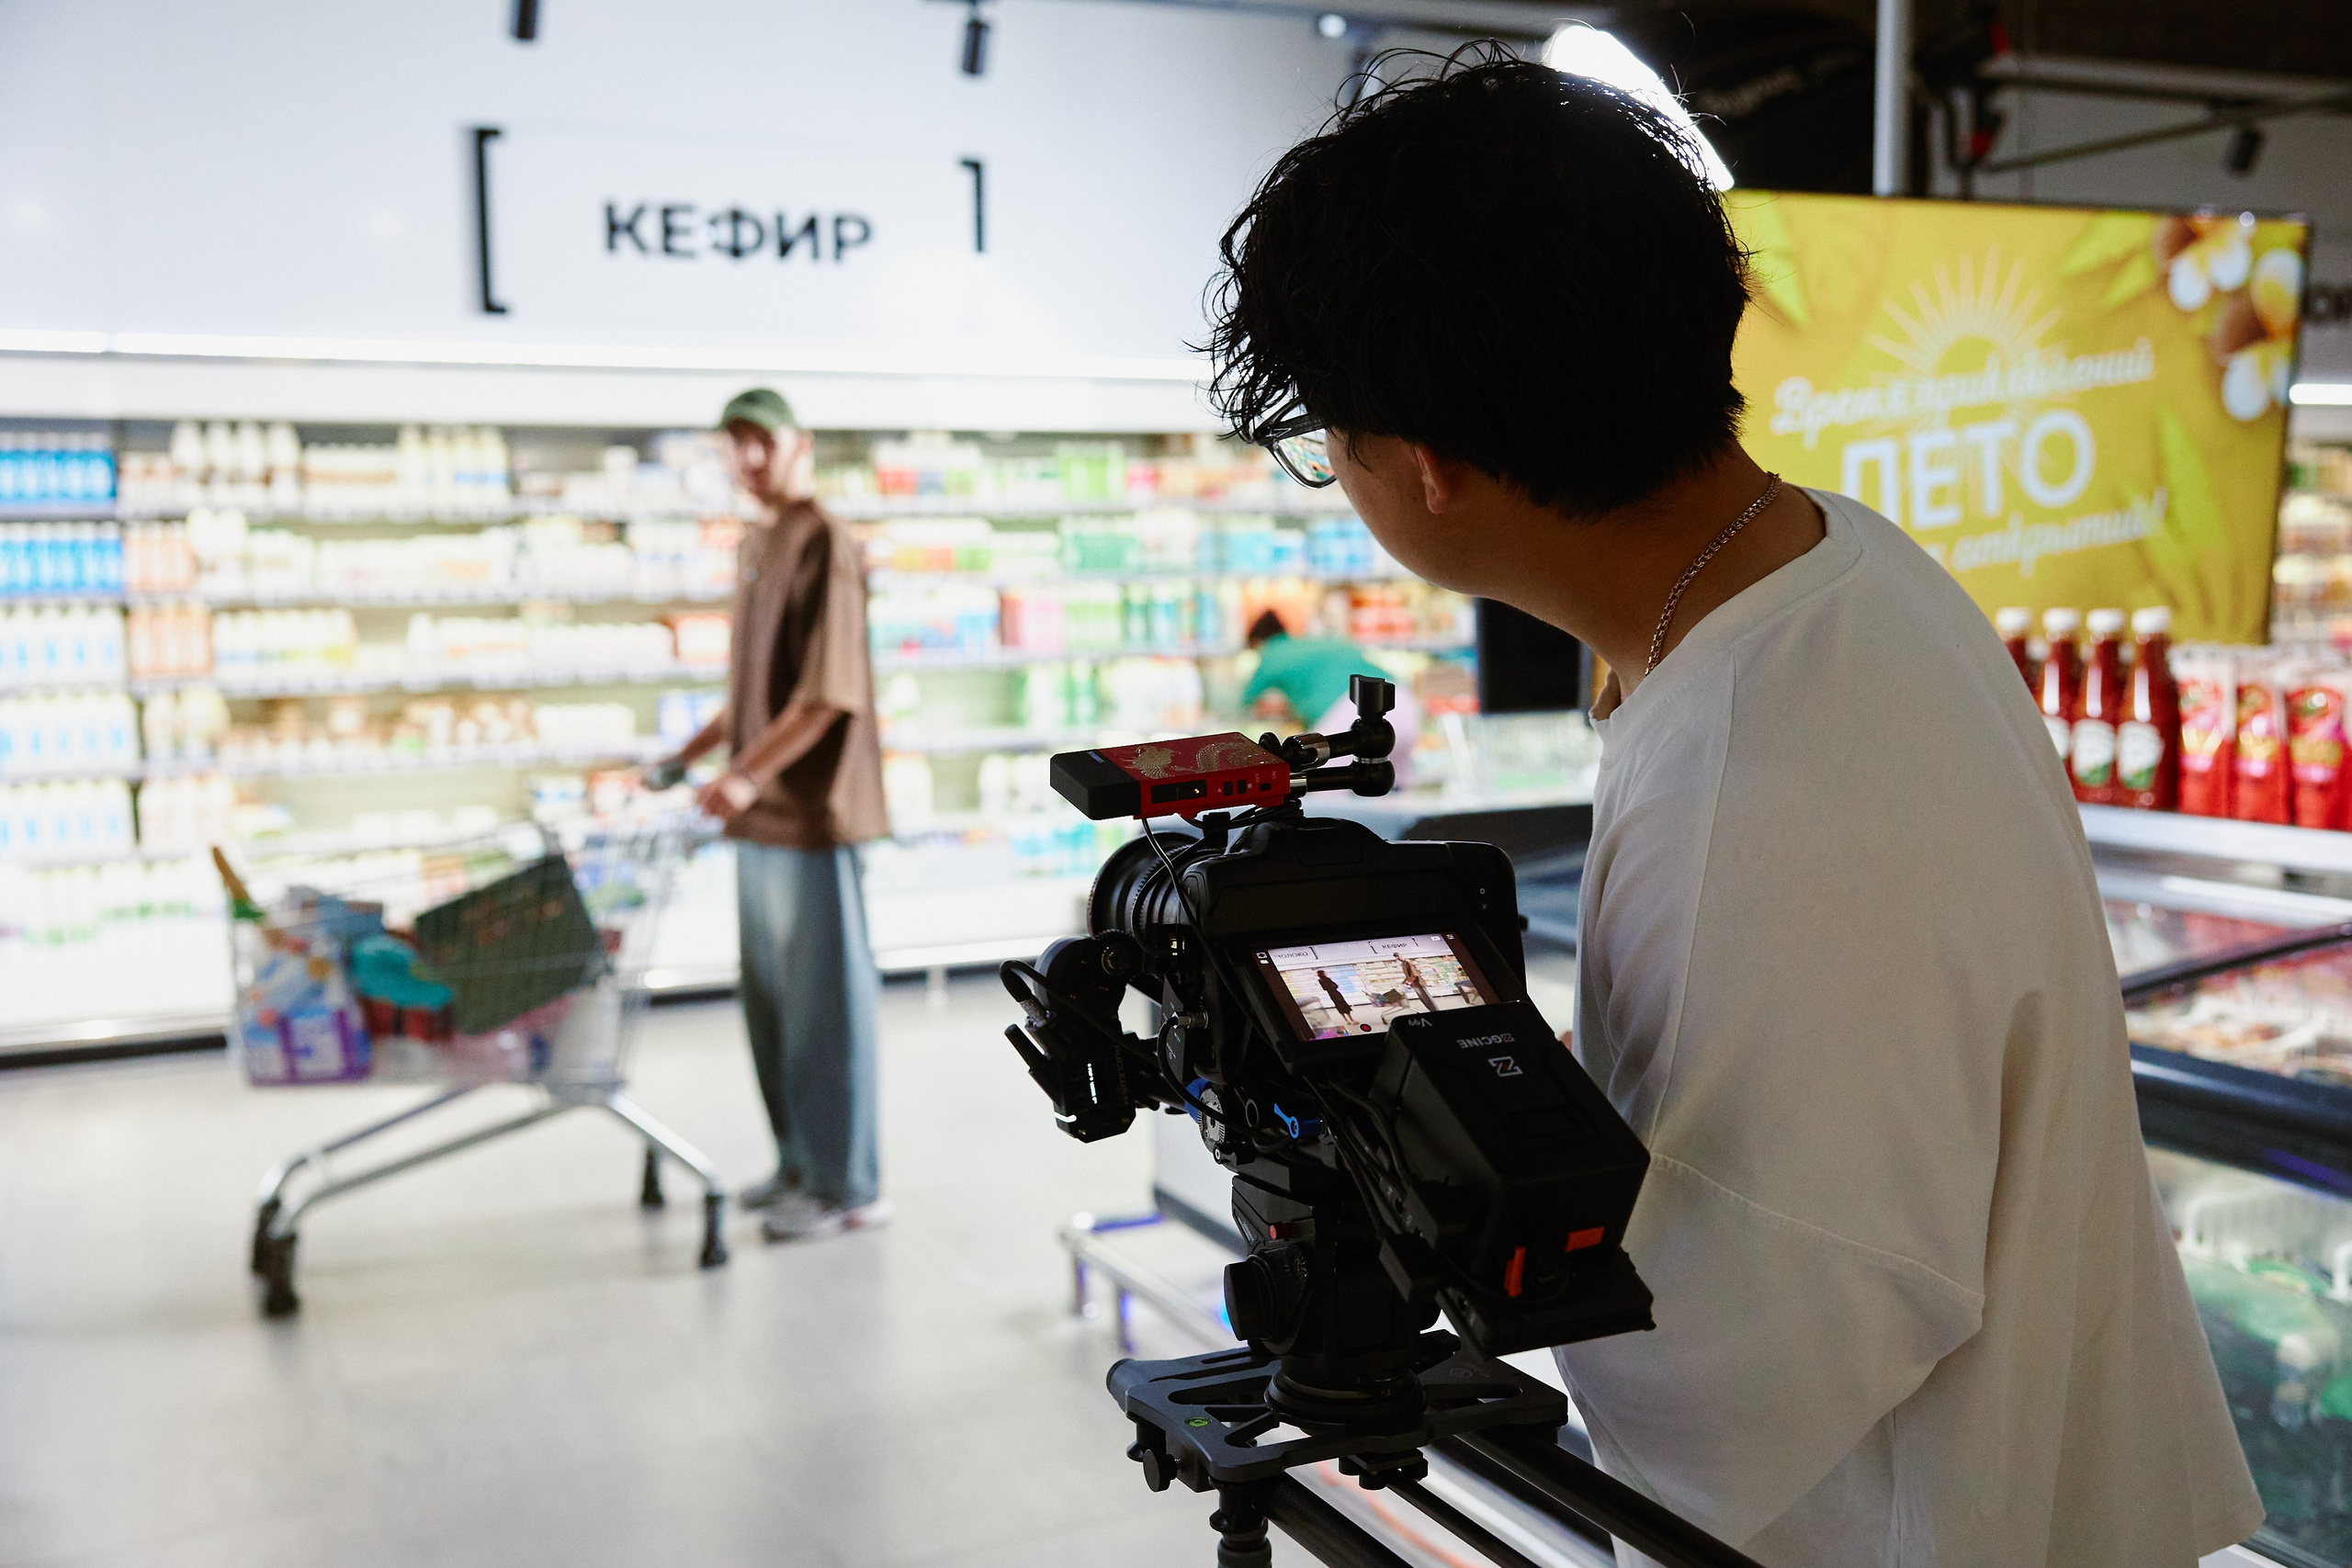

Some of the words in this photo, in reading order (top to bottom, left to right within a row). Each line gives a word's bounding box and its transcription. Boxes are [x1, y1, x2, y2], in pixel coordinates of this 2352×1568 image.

[604, 201, 873, 263] КЕФИР
[1381, 942, 1408, 951] КЕФИР
[1408, 1017, 1432, 1028] V99
[1456, 1032, 1515, 1049] ZGCINE
